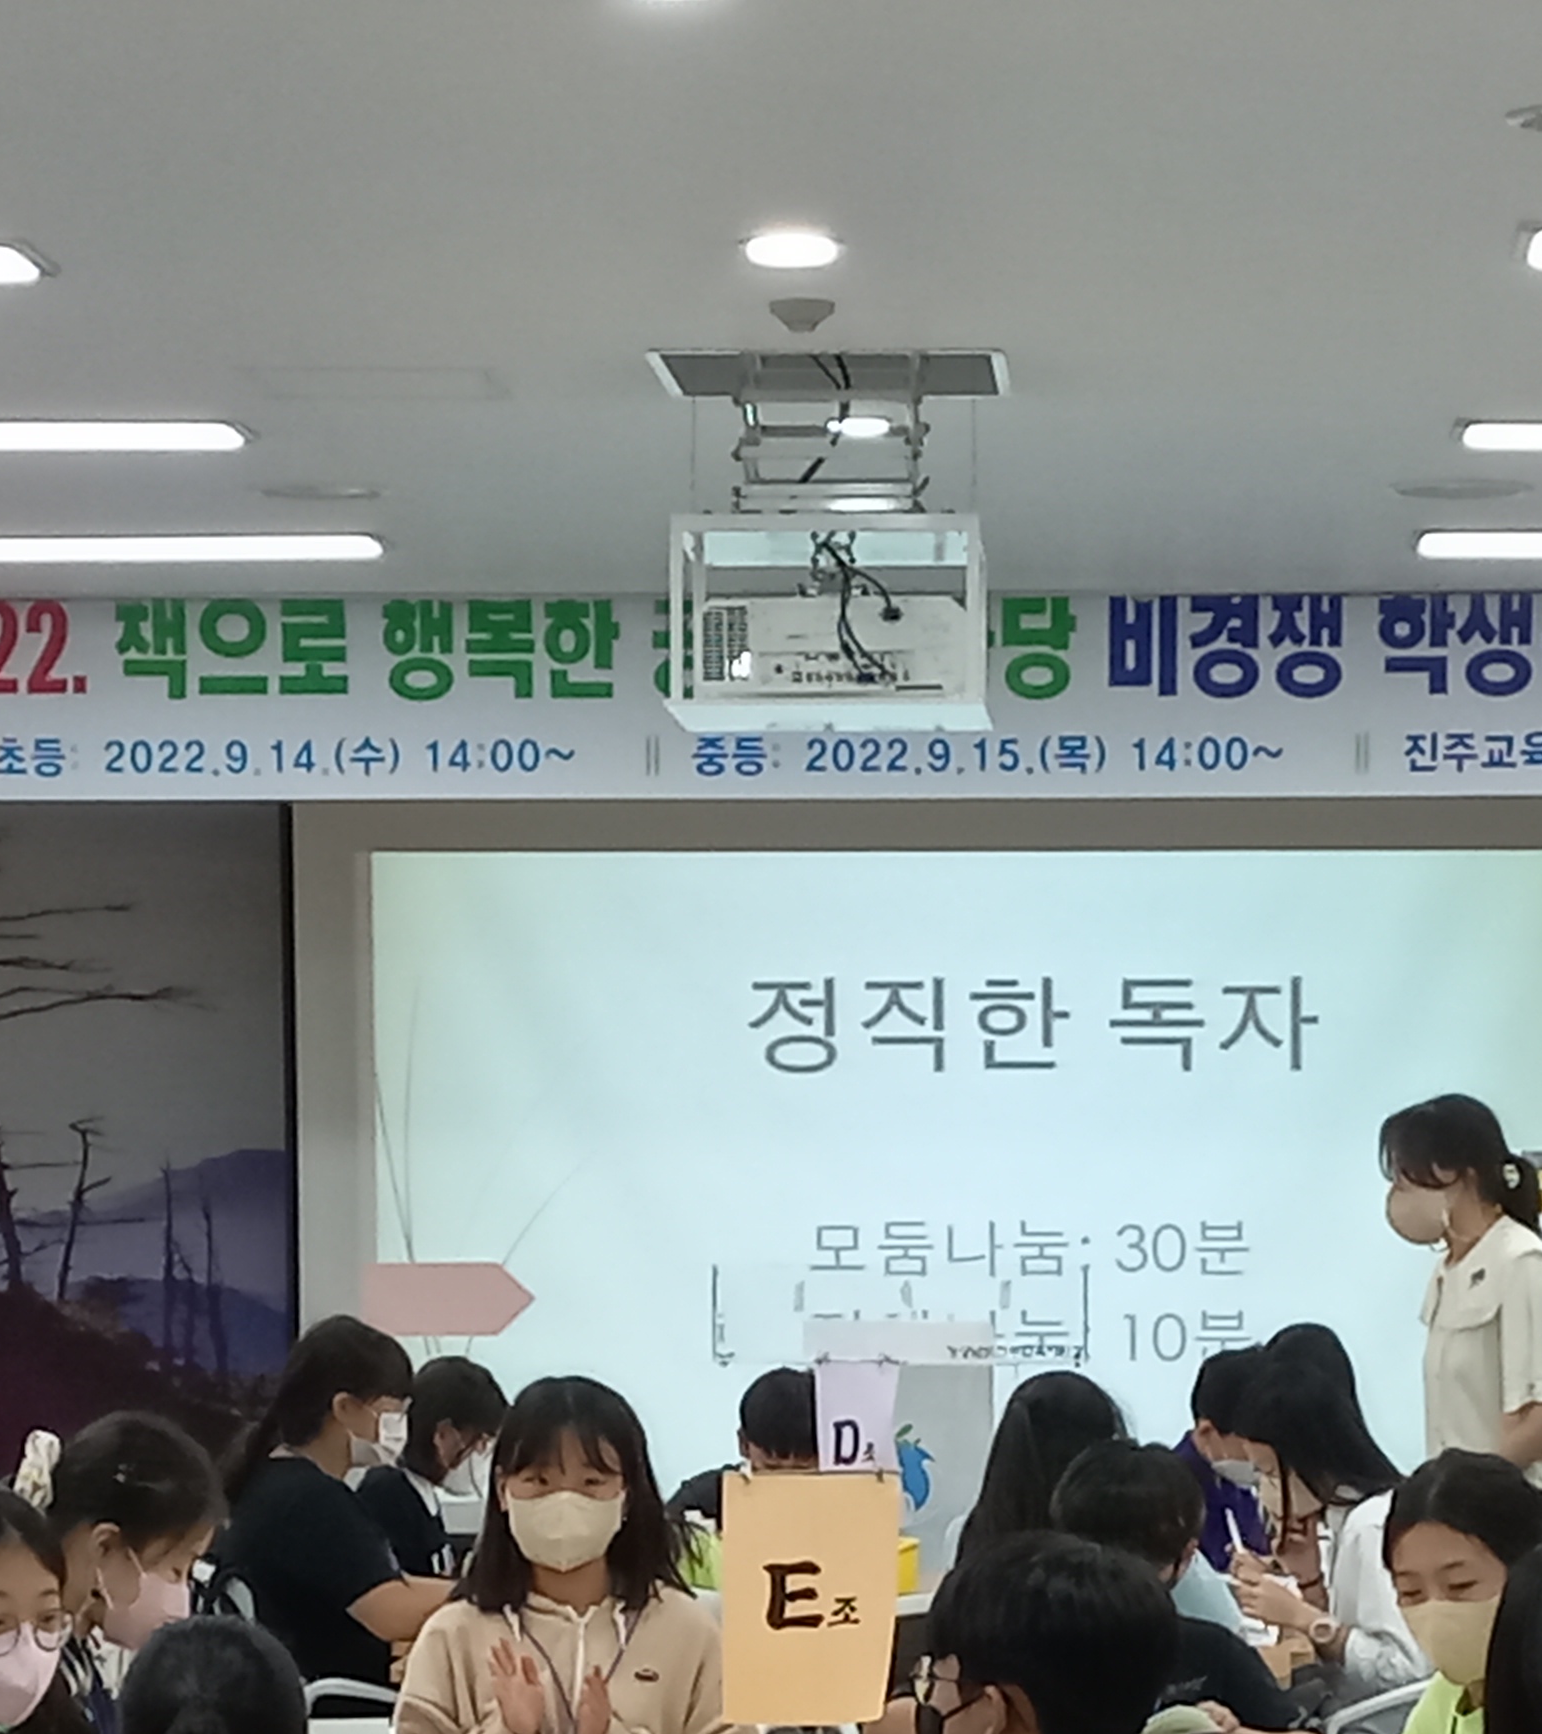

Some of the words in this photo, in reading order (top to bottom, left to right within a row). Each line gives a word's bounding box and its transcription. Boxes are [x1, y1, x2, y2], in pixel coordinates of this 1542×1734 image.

[114, 598, 350, 700] 책으로
[382, 598, 619, 701] 행복한
[1106, 594, 1345, 699] 비경쟁
[103, 736, 401, 778] 2022.9.14.(수)
[424, 738, 576, 773] 14:00~
[691, 737, 780, 777] 중등:
[804, 736, 1107, 777] 2022.9.15.(목)
[1132, 734, 1284, 773] 14:00~
[747, 973, 1072, 1076] 정직한
[1107, 973, 1320, 1074] 독자
[809, 1219, 1091, 1277] 모둠나눔:
[1114, 1218, 1252, 1276] 30분
[1124, 1309, 1254, 1361] 10분
